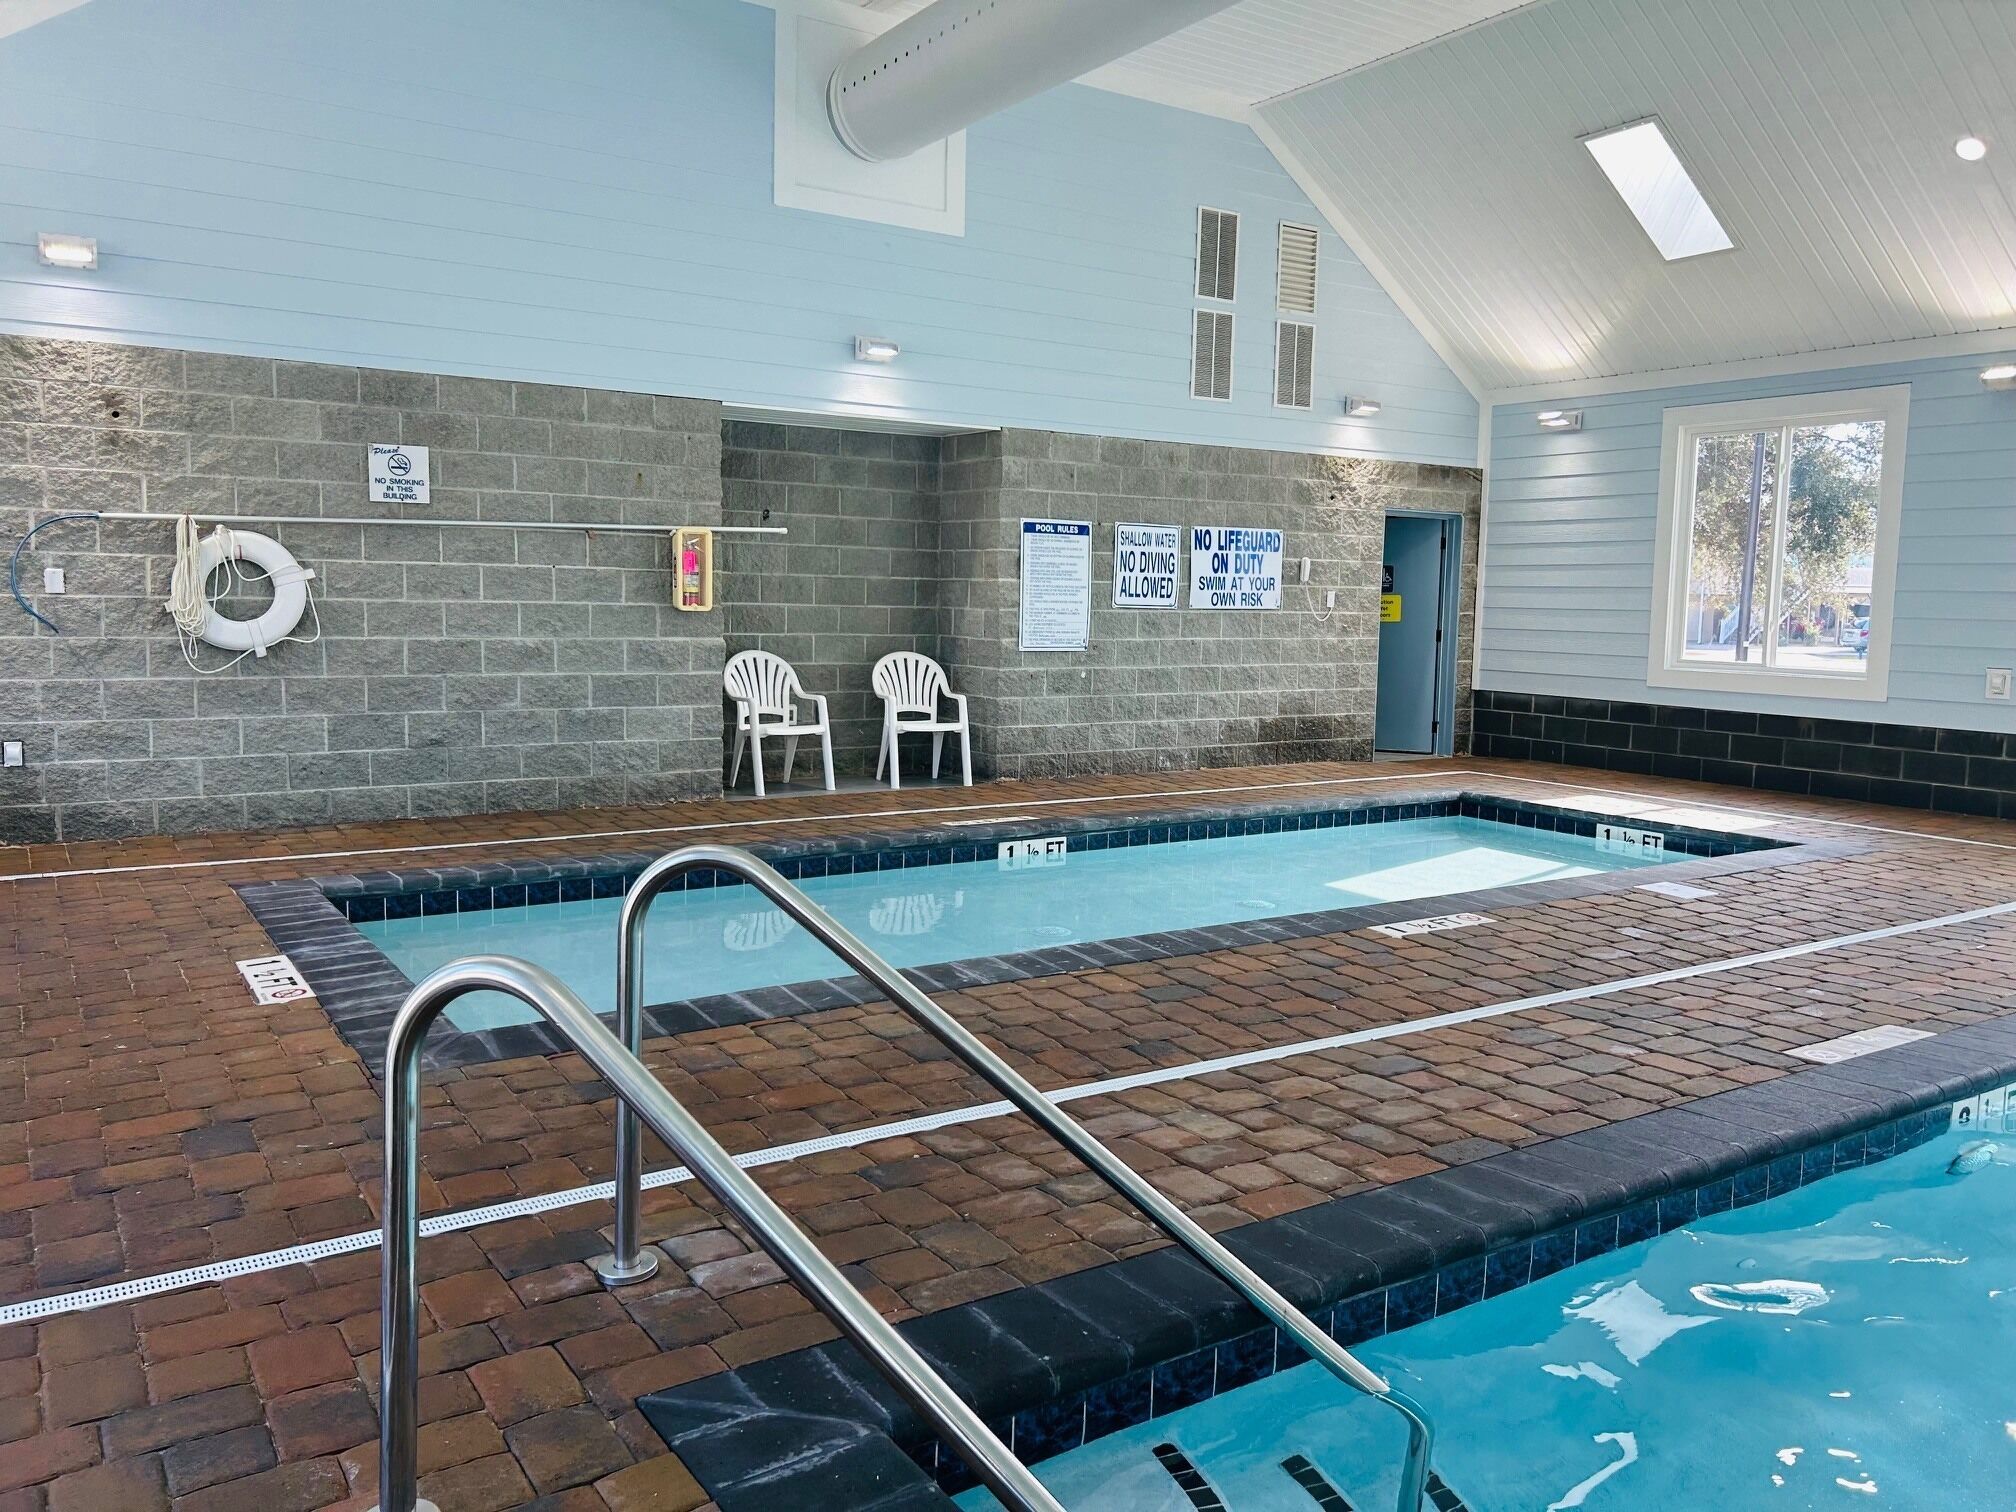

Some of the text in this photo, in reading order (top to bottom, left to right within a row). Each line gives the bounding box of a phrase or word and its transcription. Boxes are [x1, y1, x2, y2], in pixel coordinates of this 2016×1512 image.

[372, 447, 398, 456] Please
[389, 478, 425, 486] SMOKING
[383, 492, 417, 500] BUILDING
[1035, 524, 1079, 534] POOL RULES
[1120, 530, 1177, 548] SHALLOW WATER
[1194, 528, 1281, 553] NO LIFEGUARD
[1119, 550, 1175, 574] NO DIVING
[1211, 552, 1264, 575] ON DUTY
[1119, 575, 1174, 598] ALLOWED
[1198, 576, 1276, 591] SWIM AT YOUR
[1210, 592, 1264, 607] OWN RISK
[1603, 828, 1611, 841] 1
[1642, 833, 1662, 849] FT
[1006, 844, 1015, 858] 1
[1046, 840, 1065, 855] FT
[1384, 925, 1408, 934] 1
[1428, 917, 1463, 927] FT
[257, 976, 299, 989] FT
